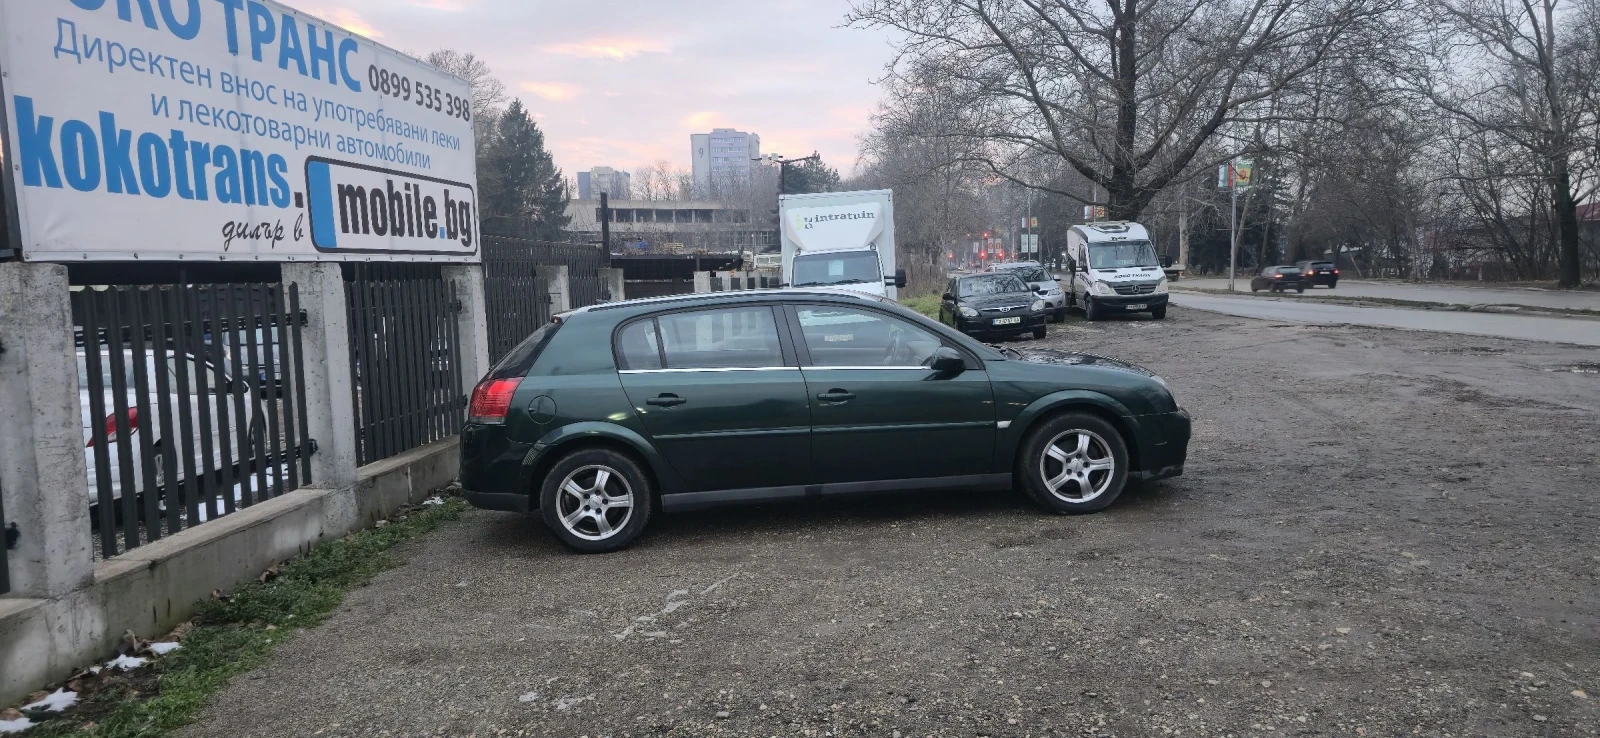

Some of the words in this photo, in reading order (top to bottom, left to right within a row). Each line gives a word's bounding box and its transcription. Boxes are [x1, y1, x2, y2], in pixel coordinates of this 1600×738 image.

[214, 0, 362, 92] ТРАНС
[54, 17, 212, 89] Директен
[220, 71, 278, 105] внос
[283, 88, 307, 112] на
[312, 96, 428, 143] употребявани
[431, 129, 460, 151] леки
[368, 64, 411, 101] 0899
[415, 81, 442, 112] 535
[445, 92, 471, 121] 398
[150, 93, 170, 118] и
[178, 99, 331, 150] лекотоварни
[336, 132, 431, 169] автомобили
[222, 219, 285, 252] дилър
[337, 179, 472, 247] mobile.bg
[815, 210, 875, 223] intratuin
